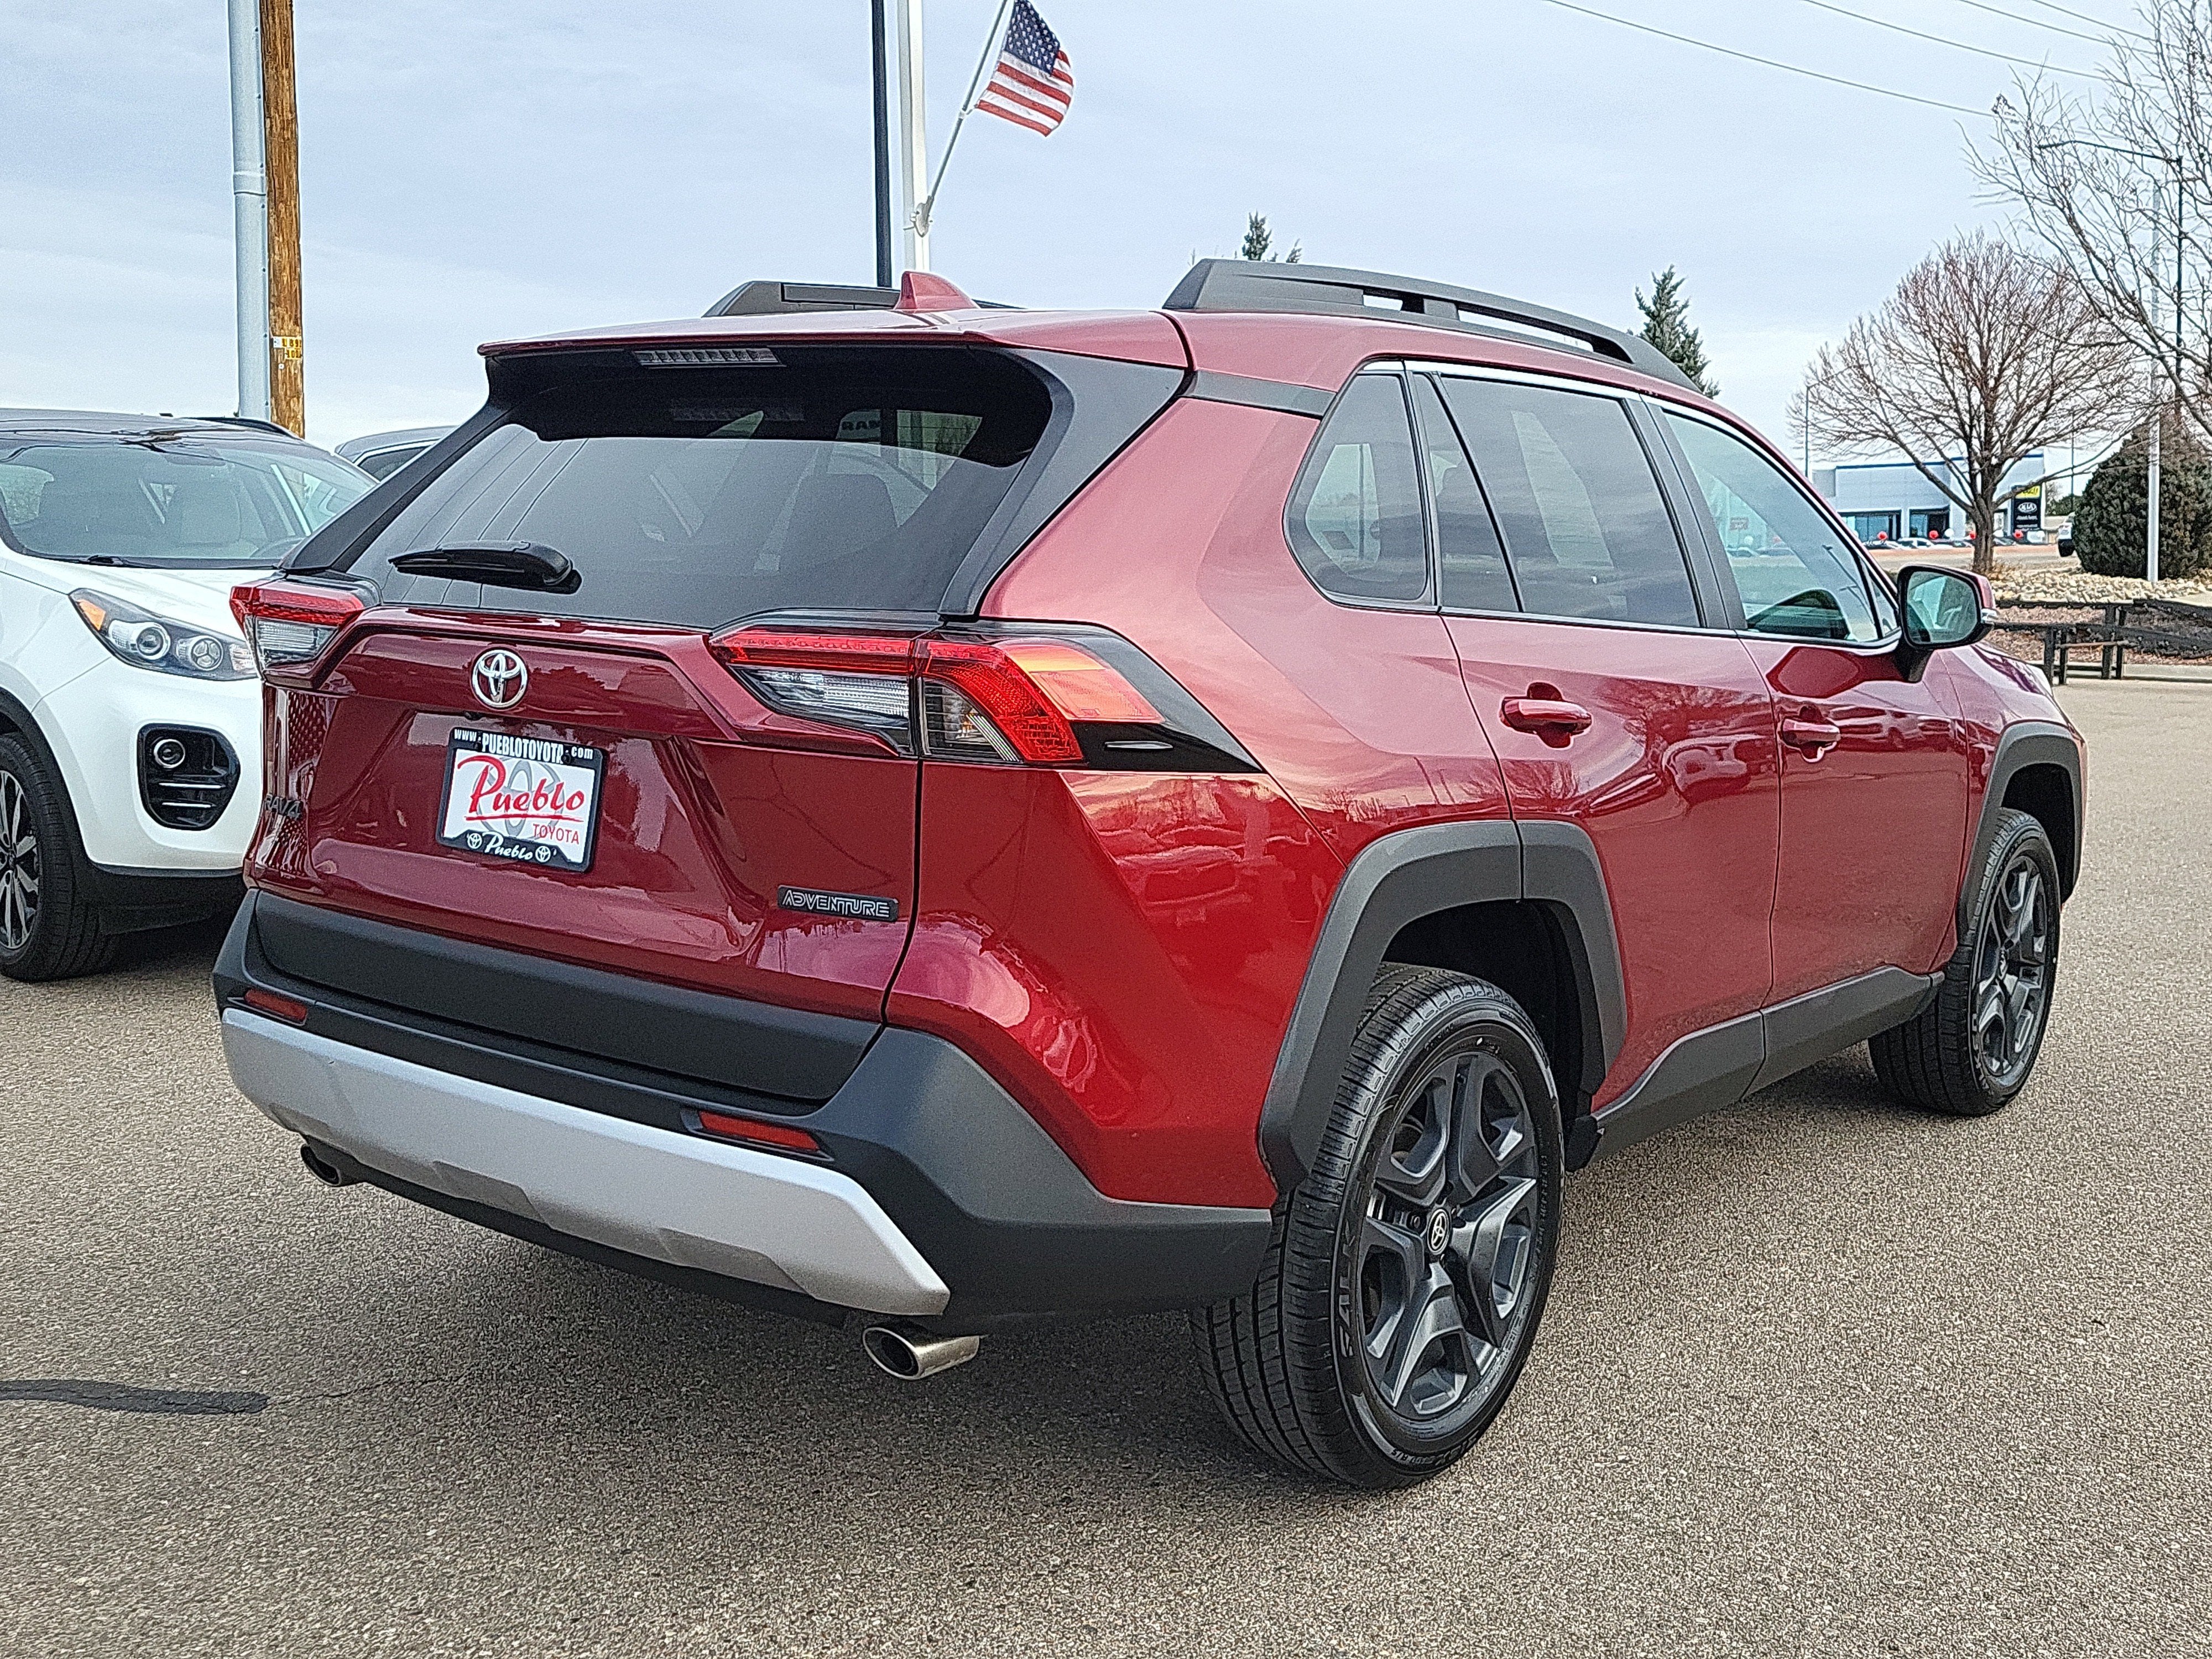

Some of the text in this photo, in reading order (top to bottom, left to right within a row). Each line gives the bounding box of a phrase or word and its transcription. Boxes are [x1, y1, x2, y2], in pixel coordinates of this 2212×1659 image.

[457, 755, 585, 813] Pueblo
[265, 792, 300, 820] RAV4
[482, 831, 533, 860] Pueblo
[533, 823, 580, 845] TOYOTA
[782, 890, 890, 918] ADVENTURE
